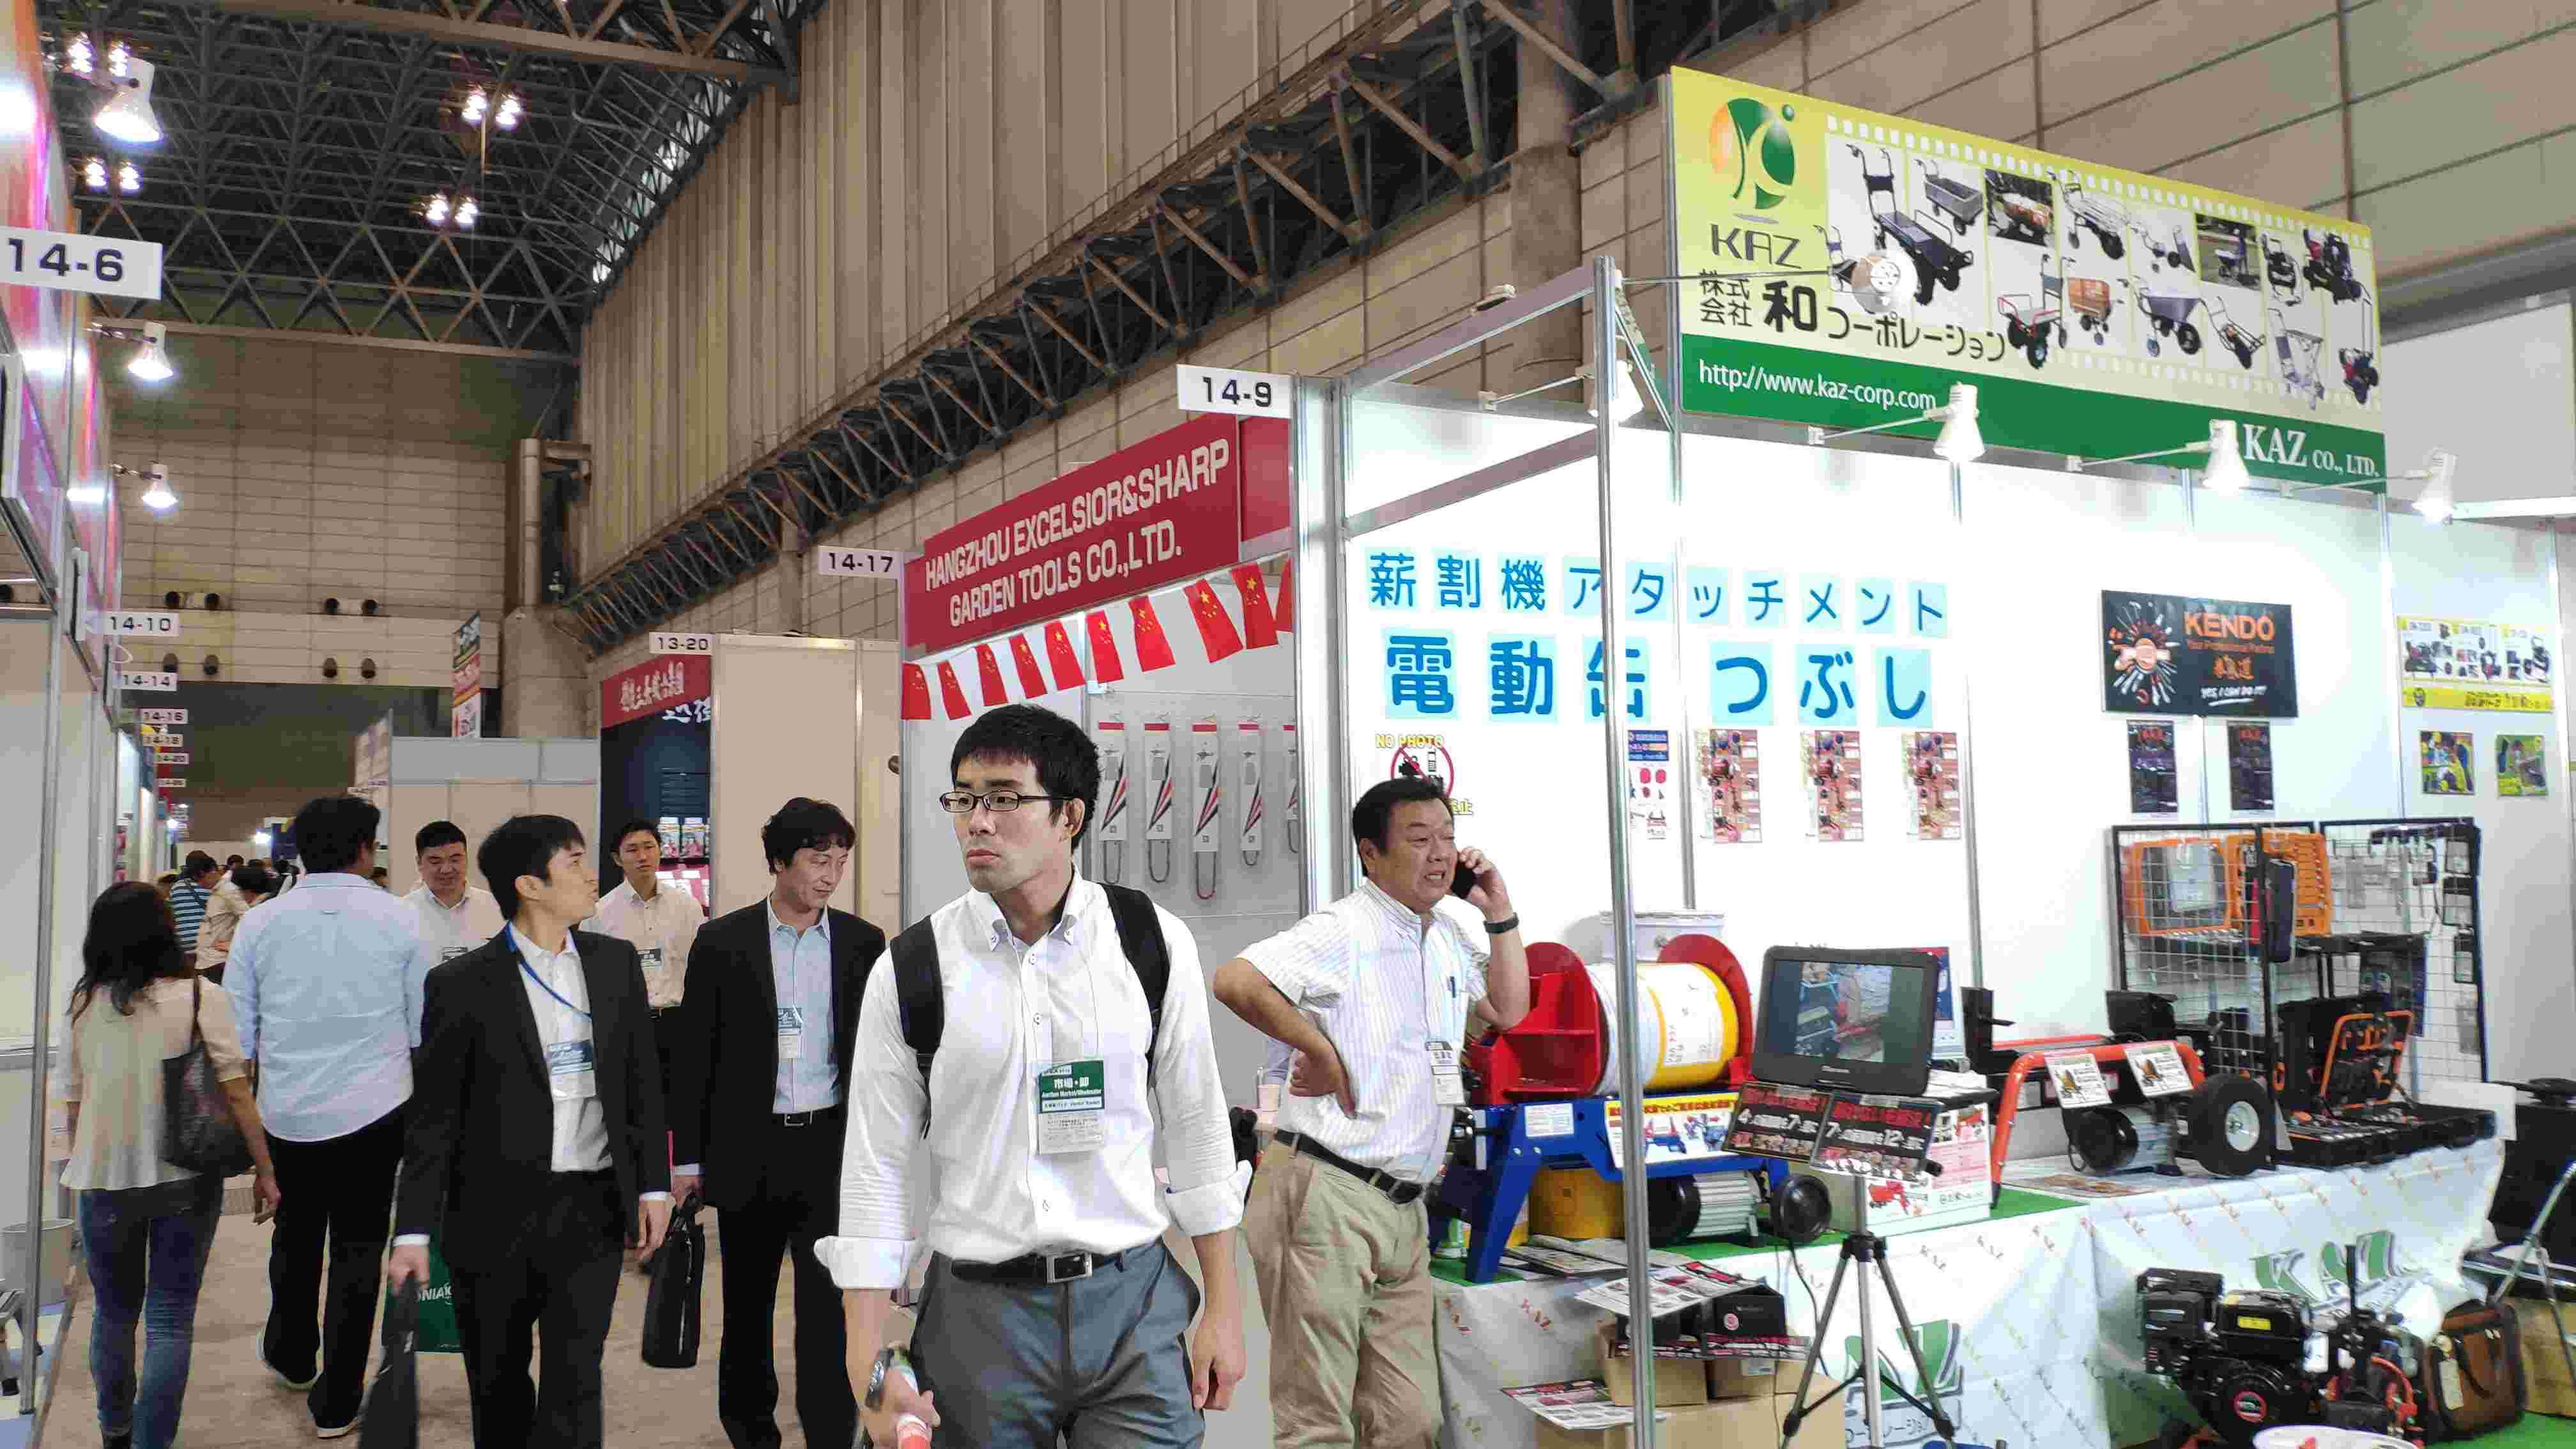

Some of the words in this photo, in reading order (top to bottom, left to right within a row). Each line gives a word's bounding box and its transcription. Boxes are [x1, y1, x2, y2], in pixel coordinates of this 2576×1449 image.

[8, 237, 123, 282] 14-6
[1710, 224, 1802, 269] KAZ
[1202, 376, 1271, 408] 14-9
[1699, 359, 1935, 410] http://www.kaz-corp.com
[2243, 424, 2308, 467] KAZ
[2347, 454, 2381, 477] LTD.
[925, 526, 1011, 591] HANGZHOU
[1015, 438, 1230, 557] EXCELSIOR&SHARP
[829, 552, 894, 573] 14-17
[950, 576, 1016, 627] GARDEN
[1018, 551, 1082, 601] TOOLS
[110, 615, 171, 632] 14-10
[2184, 613, 2275, 641] KENDO
[657, 637, 709, 650] 13-20
[123, 674, 171, 687] 14-14
[144, 711, 183, 721] 14-16
[1375, 734, 1394, 748] NO
[1399, 734, 1444, 749] PHOTO
